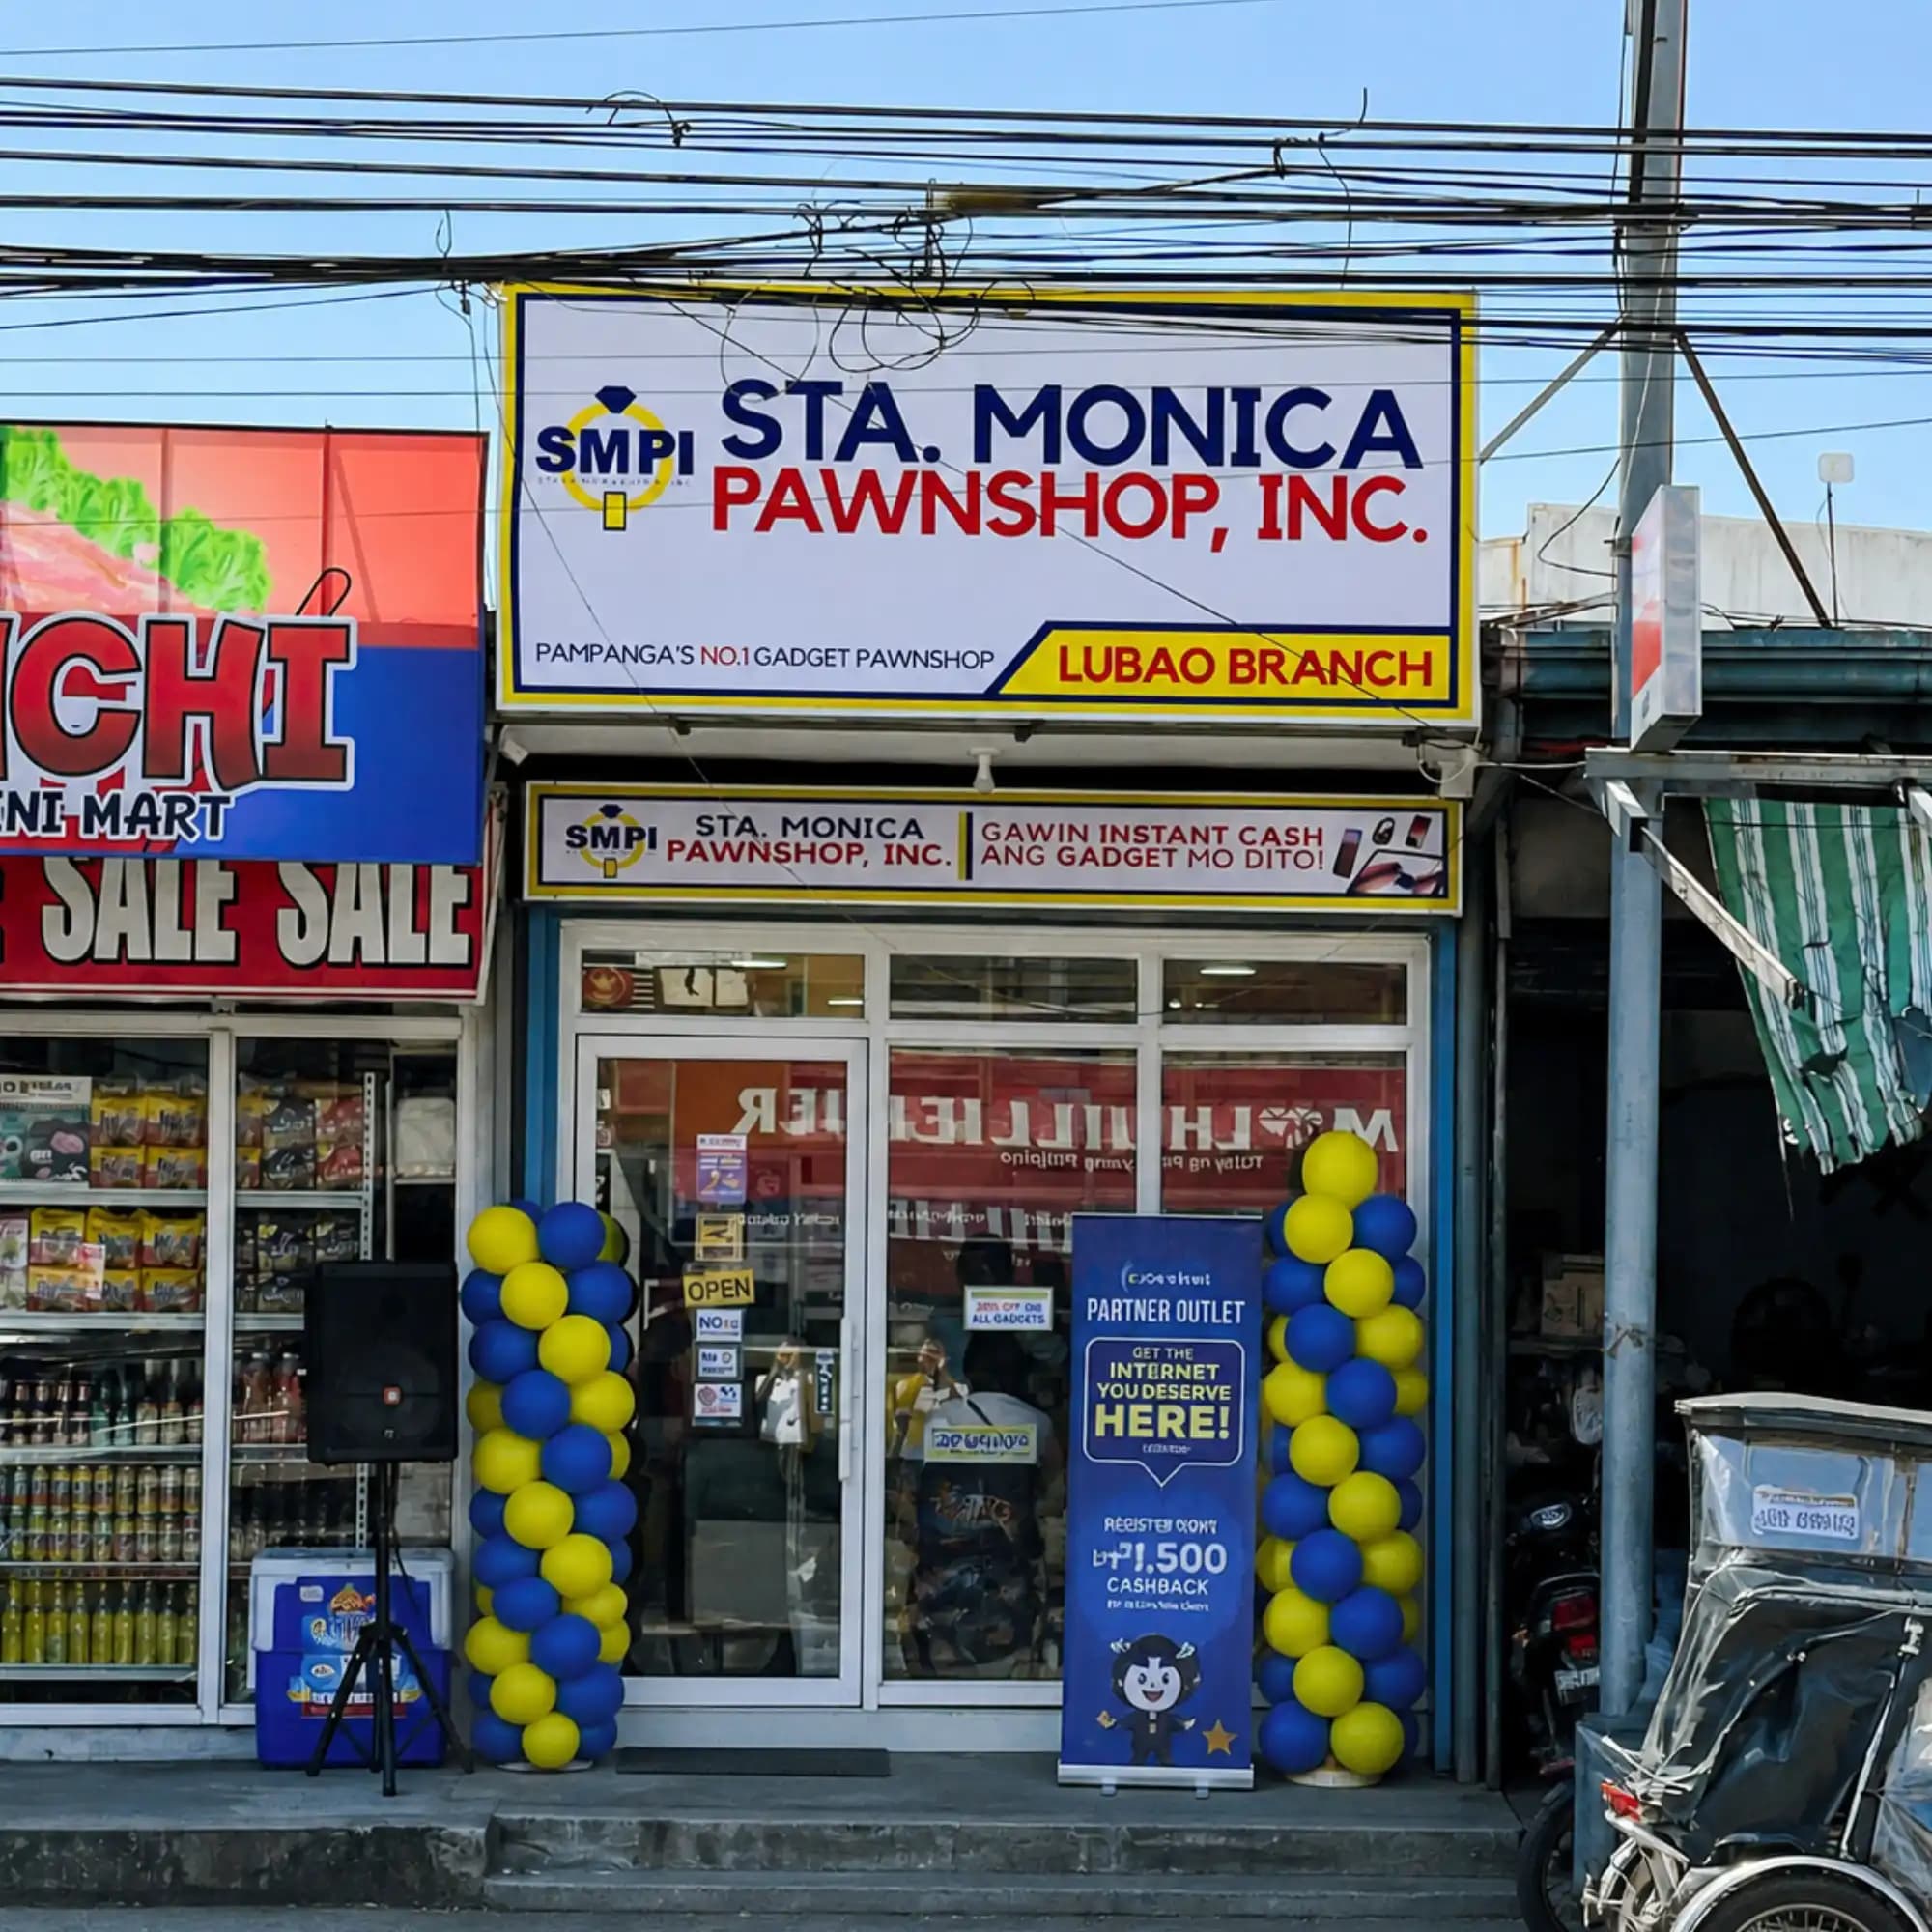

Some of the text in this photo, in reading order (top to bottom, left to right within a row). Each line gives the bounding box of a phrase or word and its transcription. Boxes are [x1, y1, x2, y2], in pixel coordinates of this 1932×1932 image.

[722, 378, 1424, 470] STA. MONICA
[535, 426, 694, 476] SMPI
[713, 466, 1428, 554] PAWNSHOP, INC.
[535, 642, 995, 670] PAMPANGA'S NO.1 GADGET PAWNSHOP
[1059, 644, 1433, 687] LUBAO BRANCH
[0, 614, 355, 792] CHI
[0, 792, 231, 838] NI MART
[696, 814, 925, 840] STA. MONICA
[565, 824, 658, 850] SMPI
[981, 822, 1323, 846] GAWIN INSTANT CASH
[667, 839, 952, 868] PAWNSHOP, INC.
[980, 845, 1324, 870] ANG GADGET MO DITO!
[41, 858, 240, 964] SALE
[276, 863, 471, 966] SALE
[688, 1277, 751, 1302] OPEN
[1087, 1297, 1246, 1324] PARTNER OUTLET
[1132, 1346, 1194, 1361] GET THE
[1110, 1361, 1220, 1381] INTERNET
[1096, 1382, 1232, 1401] YOU DESERVE
[1094, 1403, 1231, 1439] HERE!
[1106, 1577, 1209, 1596] CASHBACK
